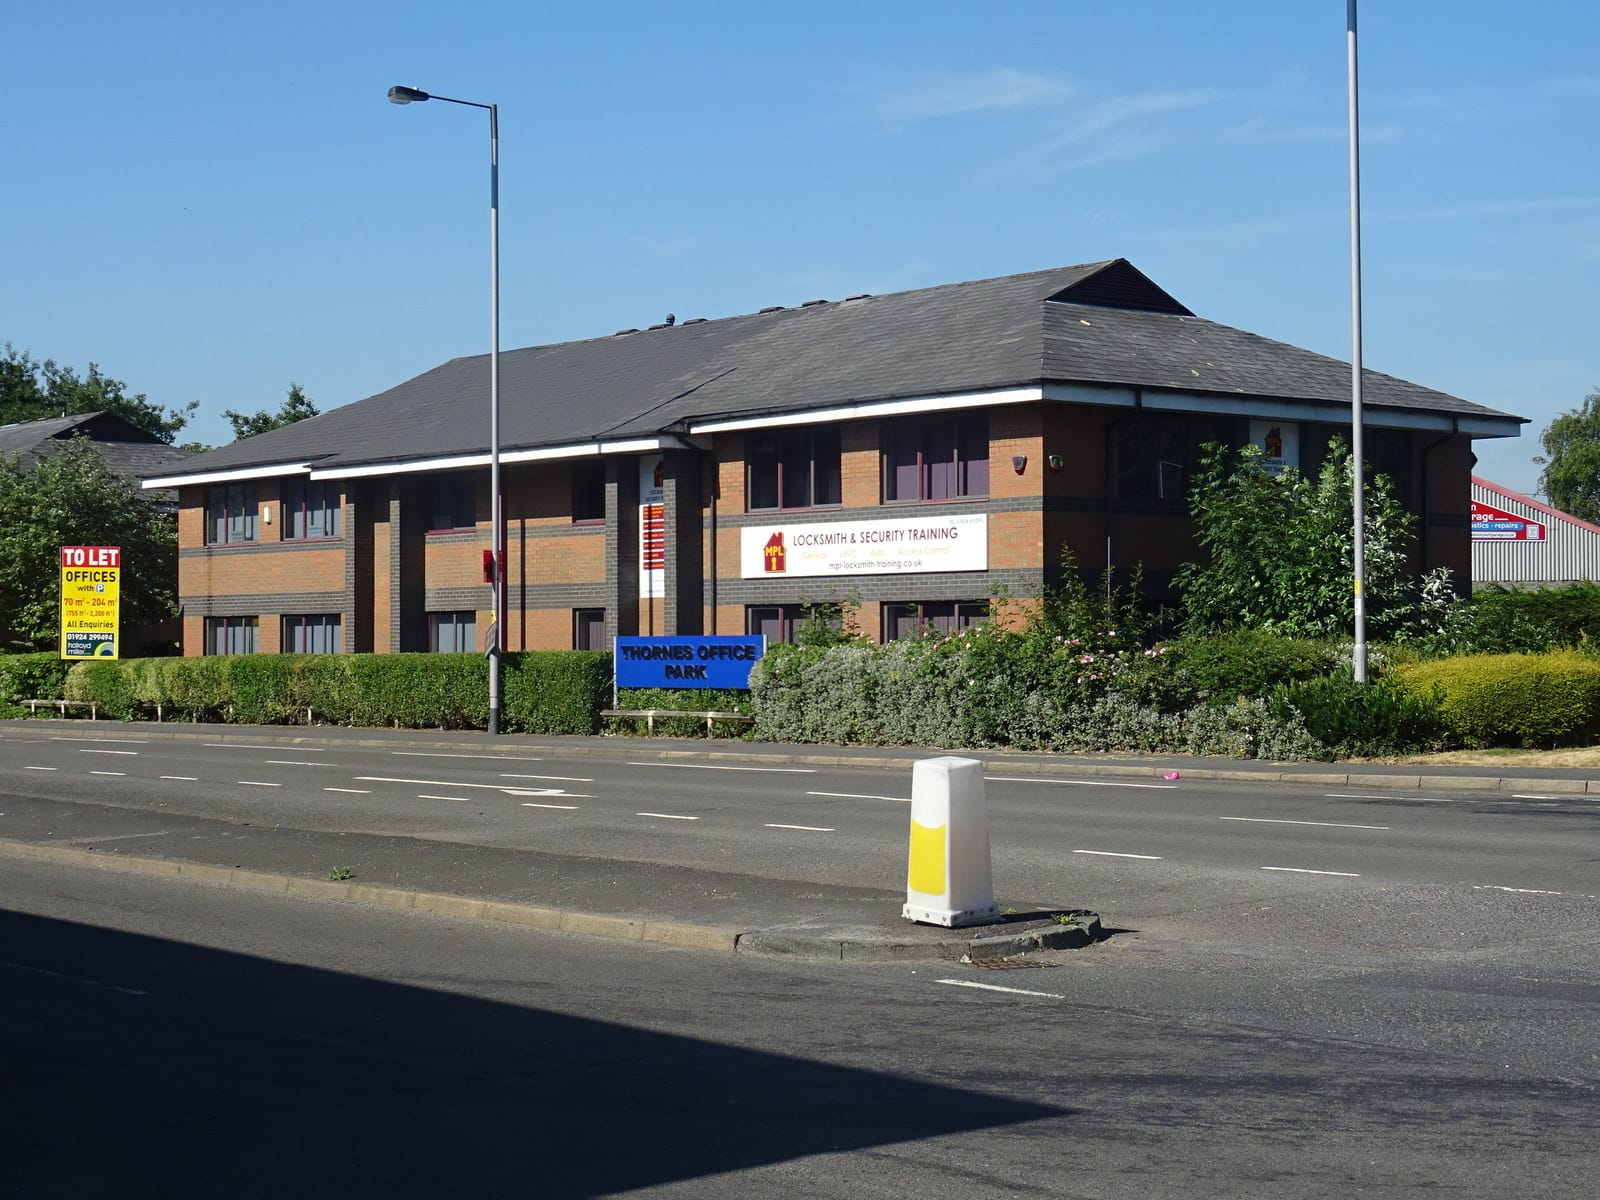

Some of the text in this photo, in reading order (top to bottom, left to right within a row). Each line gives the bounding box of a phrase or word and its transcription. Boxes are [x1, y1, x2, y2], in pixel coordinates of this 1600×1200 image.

[1494, 522, 1519, 530] repairs
[793, 526, 958, 546] LOCKSMITH & SECURITY TRAINING
[64, 548, 119, 566] TO LET
[765, 545, 784, 557] MPL
[829, 560, 923, 570] mpl-locksmith-training.co.uk
[66, 571, 116, 583] OFFICES
[64, 598, 74, 606] 70
[92, 598, 106, 607] 204
[67, 620, 114, 629] All Enquiries
[620, 645, 757, 661] THORNES OFFICE
[664, 664, 709, 680] PARK
